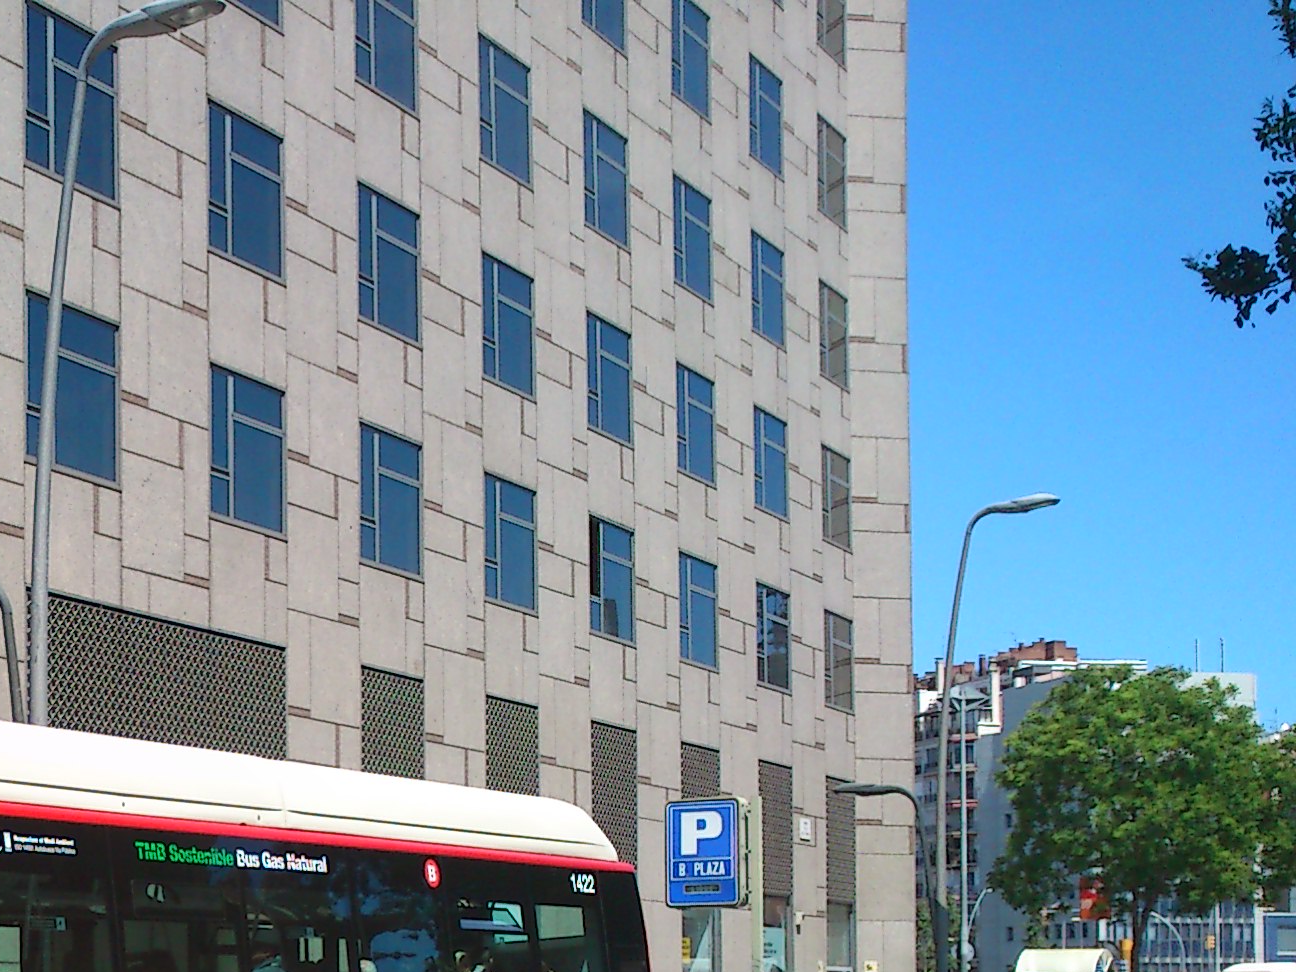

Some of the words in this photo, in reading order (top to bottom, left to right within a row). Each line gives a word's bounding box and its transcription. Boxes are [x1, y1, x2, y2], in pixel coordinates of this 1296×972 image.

[680, 810, 723, 856] P
[135, 840, 166, 861] TMB
[168, 843, 234, 868] Sostenible
[236, 849, 260, 869] Bus
[261, 851, 285, 871] Gas
[286, 852, 329, 874] Natural
[693, 861, 726, 877] PLAZA
[569, 873, 596, 895] 1422
